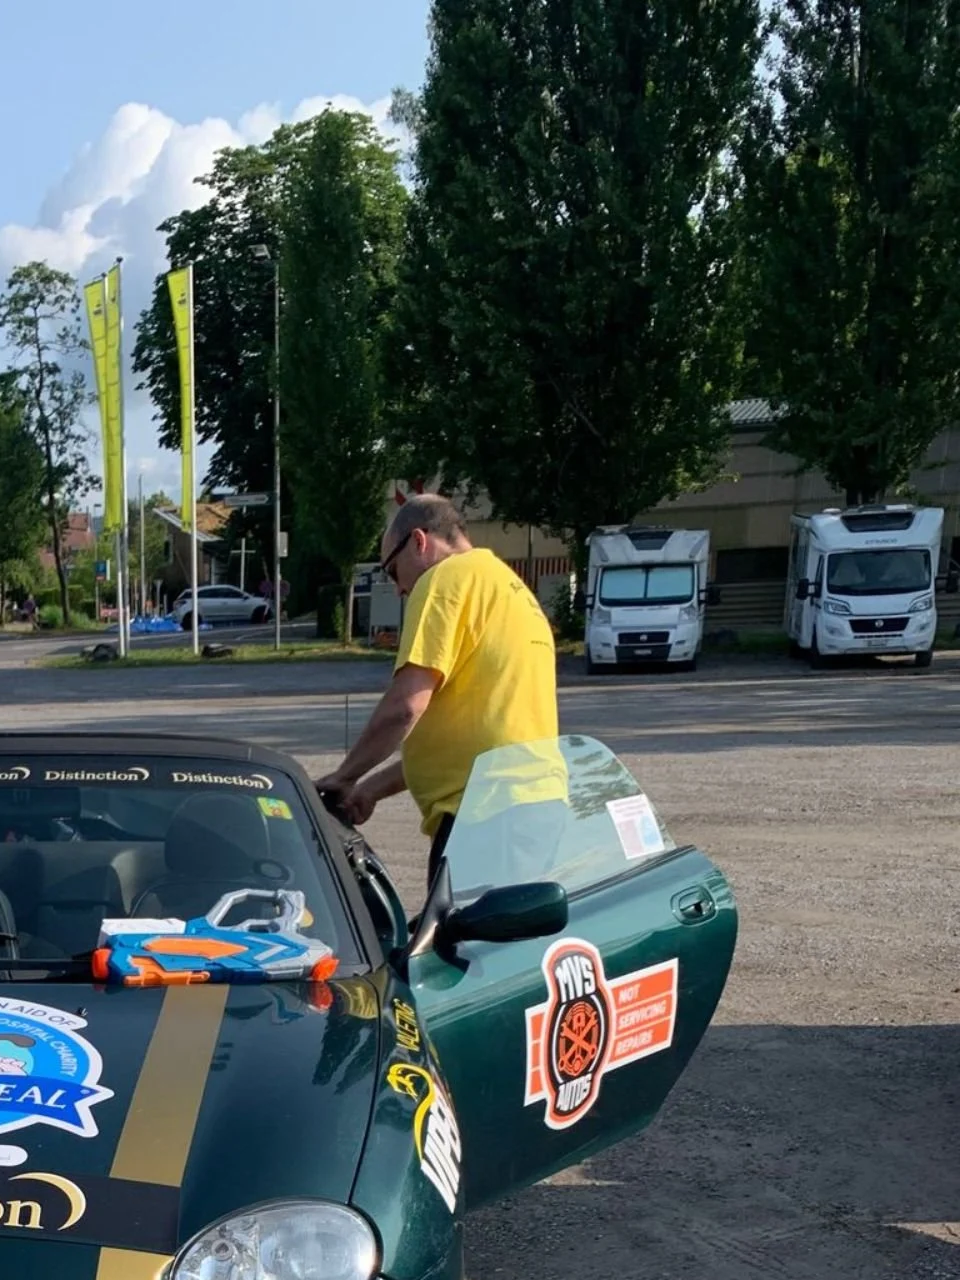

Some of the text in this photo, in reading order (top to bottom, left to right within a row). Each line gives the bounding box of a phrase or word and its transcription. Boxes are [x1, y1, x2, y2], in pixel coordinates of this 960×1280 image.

[44, 768, 139, 782] Distinction
[172, 771, 265, 789] Distinction
[554, 955, 597, 1003] MVS
[12, 1005, 47, 1017] AID
[48, 1015, 77, 1027] OF
[393, 997, 420, 1052] VALETING
[617, 1000, 668, 1030] SERVICING
[49, 1040, 79, 1077] CHARITY
[614, 1029, 655, 1056] REPAIRS
[556, 1073, 592, 1111] AUTOS
